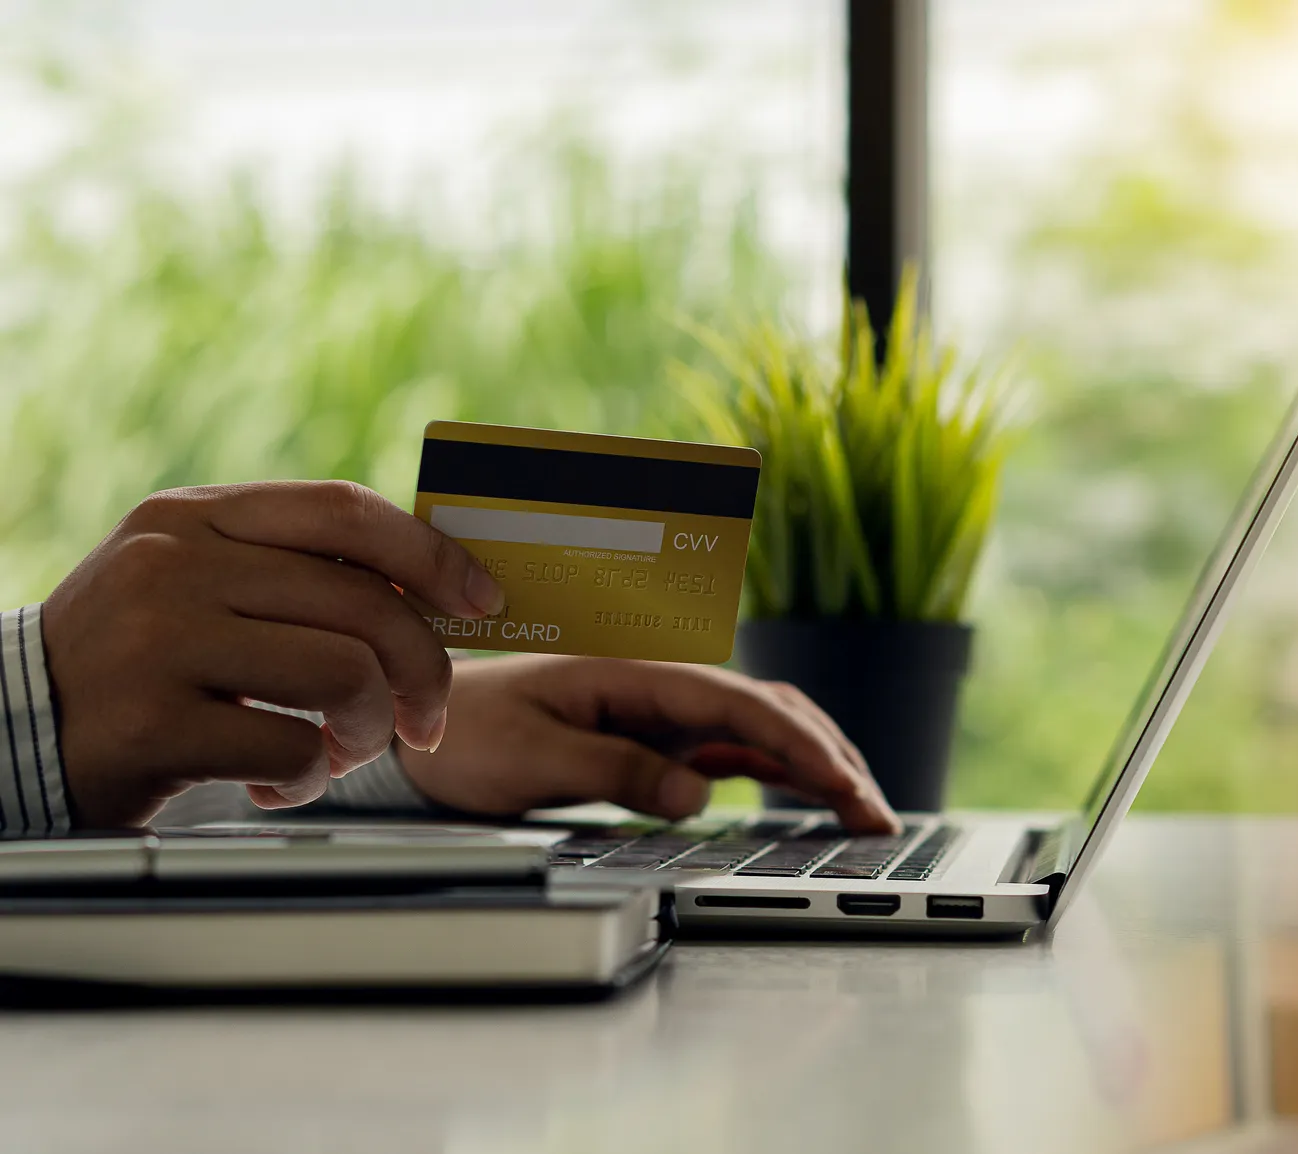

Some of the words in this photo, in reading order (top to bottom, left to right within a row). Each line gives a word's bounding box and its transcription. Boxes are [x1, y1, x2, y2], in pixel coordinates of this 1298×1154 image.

[673, 532, 719, 552] CVV
[562, 549, 612, 561] AUTHORIZED
[613, 553, 657, 564] SIGNATURE
[501, 621, 561, 642] CARD
